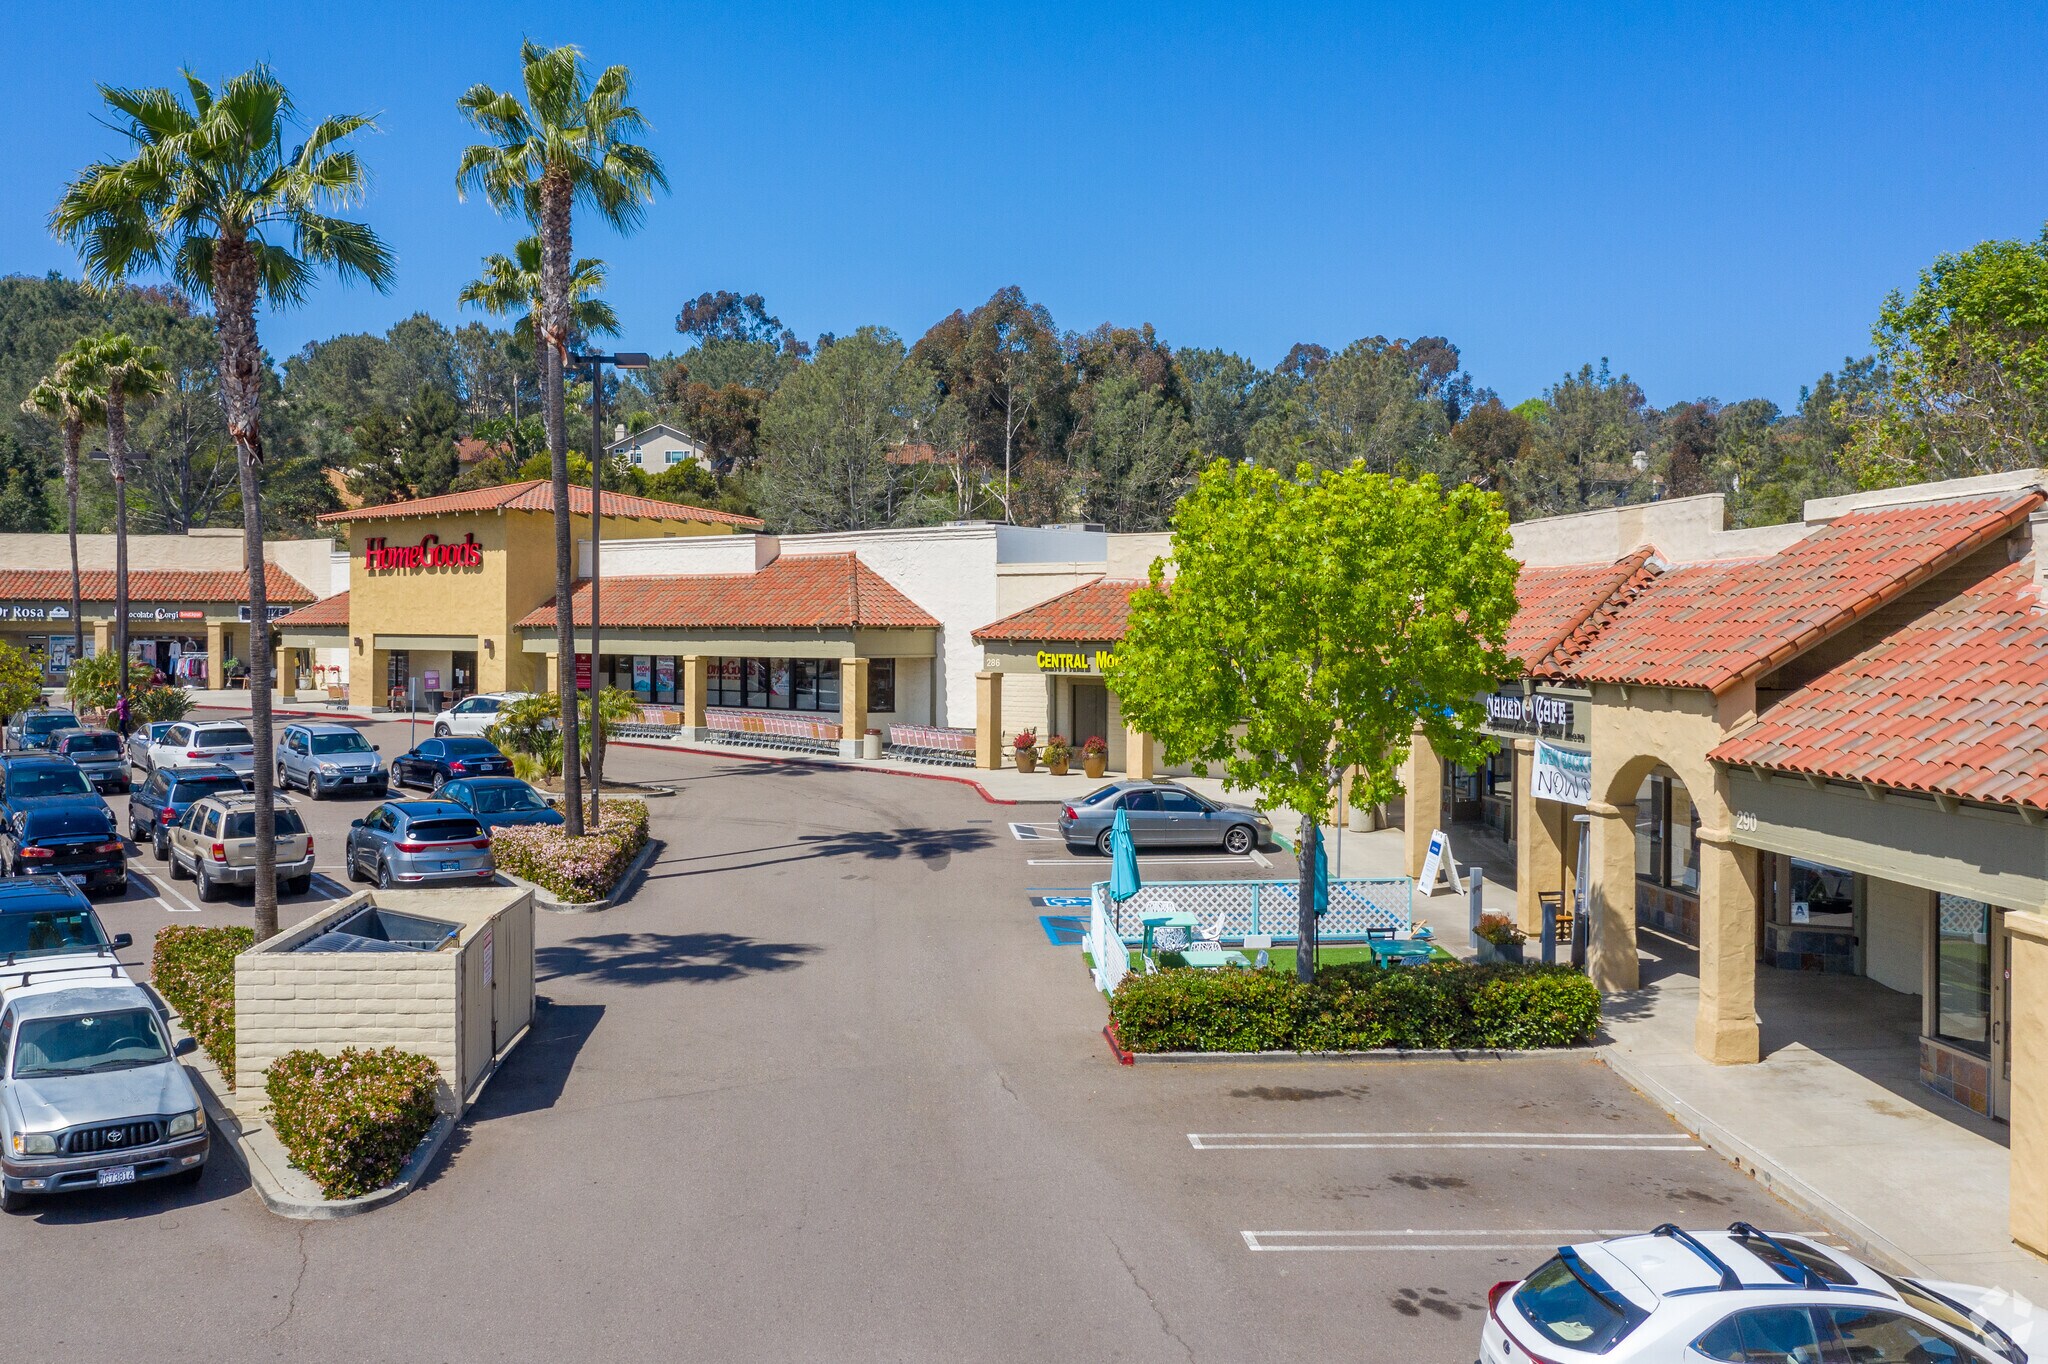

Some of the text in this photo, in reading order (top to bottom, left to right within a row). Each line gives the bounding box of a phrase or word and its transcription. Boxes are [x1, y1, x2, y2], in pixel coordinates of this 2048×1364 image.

[364, 532, 482, 570] HomeGoods
[0, 606, 9, 618] r
[13, 606, 45, 618] Rosa
[154, 602, 179, 620] Corgi
[986, 658, 1001, 667] 286
[1037, 650, 1089, 669] CENTRAL
[1538, 770, 1579, 798] NOW
[1736, 810, 1758, 833] 290
[1795, 905, 1805, 916] A
